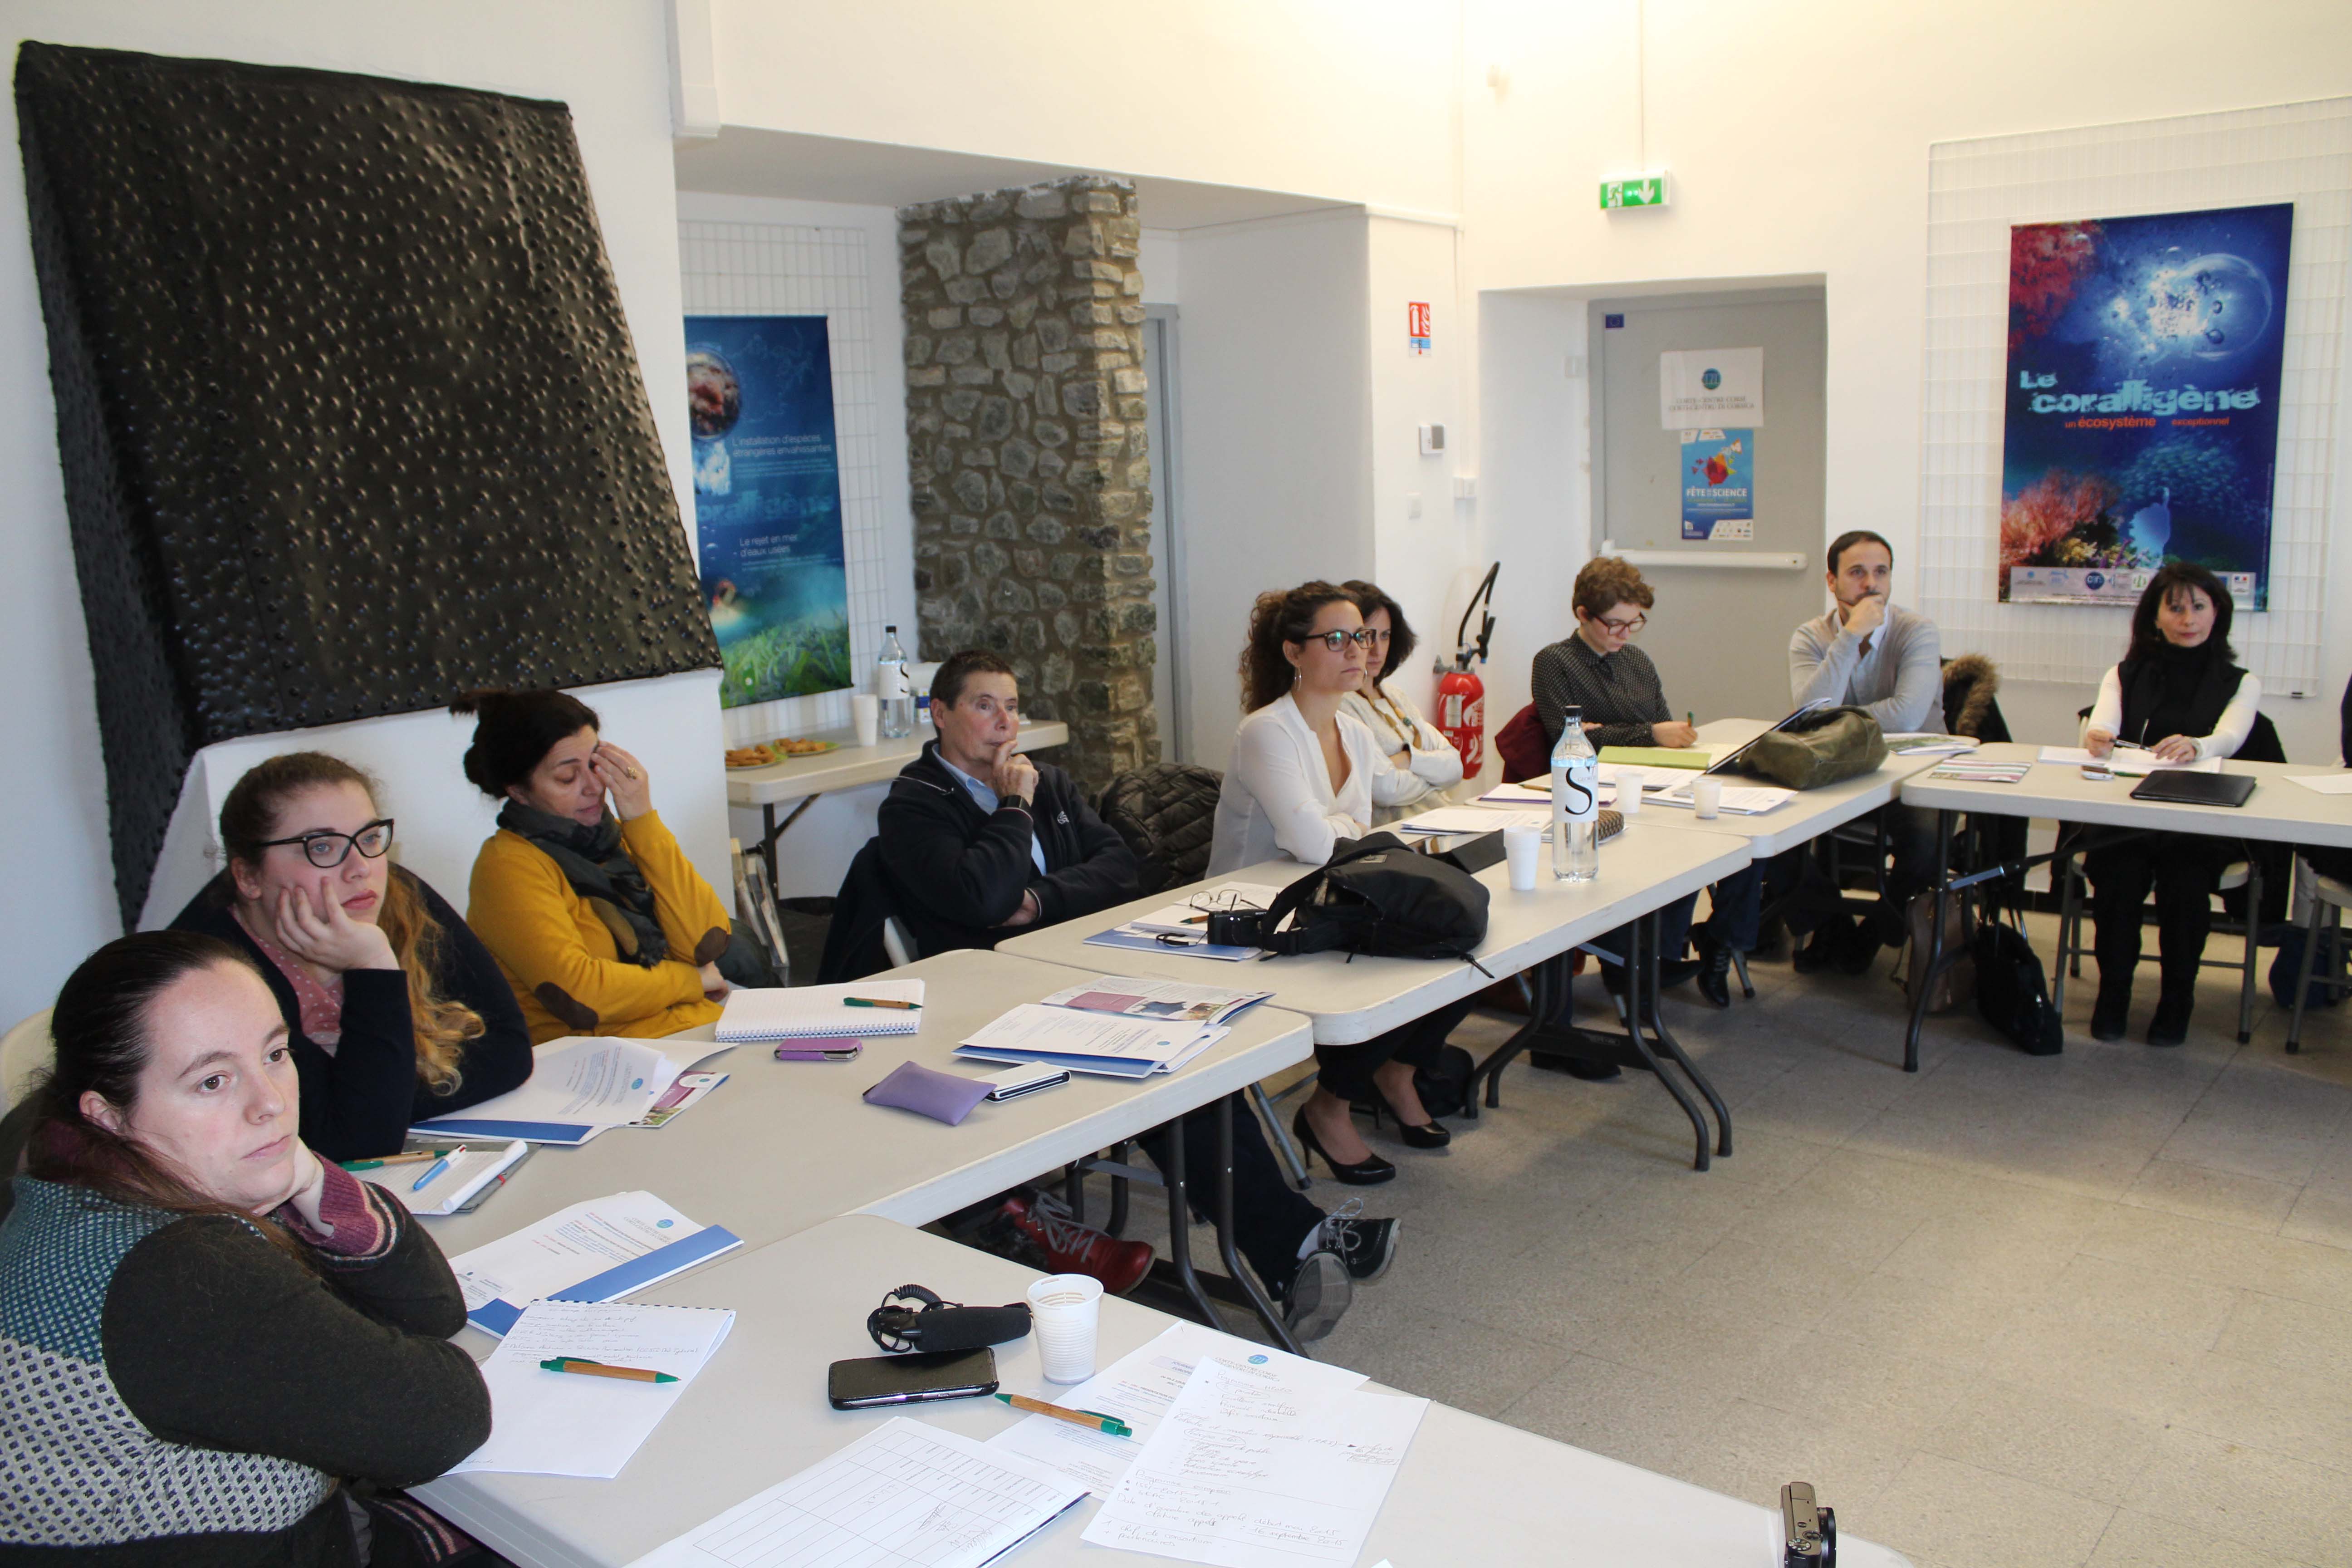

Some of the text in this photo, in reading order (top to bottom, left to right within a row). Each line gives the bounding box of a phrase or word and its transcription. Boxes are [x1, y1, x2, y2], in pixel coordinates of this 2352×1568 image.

[2019, 370, 2058, 389] Le
[2029, 379, 2260, 416] coralligène
[2078, 416, 2156, 430] écosystème
[2171, 416, 2230, 426] exceptionnel
[733, 434, 821, 446] L'installation d'espèces
[733, 444, 832, 457] étrangères envahissantes
[1686, 486, 1706, 496] FÊTE
[1713, 488, 1747, 496] SCIENCE
[739, 537, 750, 547] Le
[752, 535, 769, 545] rejet
[740, 545, 790, 558] d'eaux usées
[1135, 1469, 1181, 1486] Programme
[1117, 1493, 1136, 1505] Date
